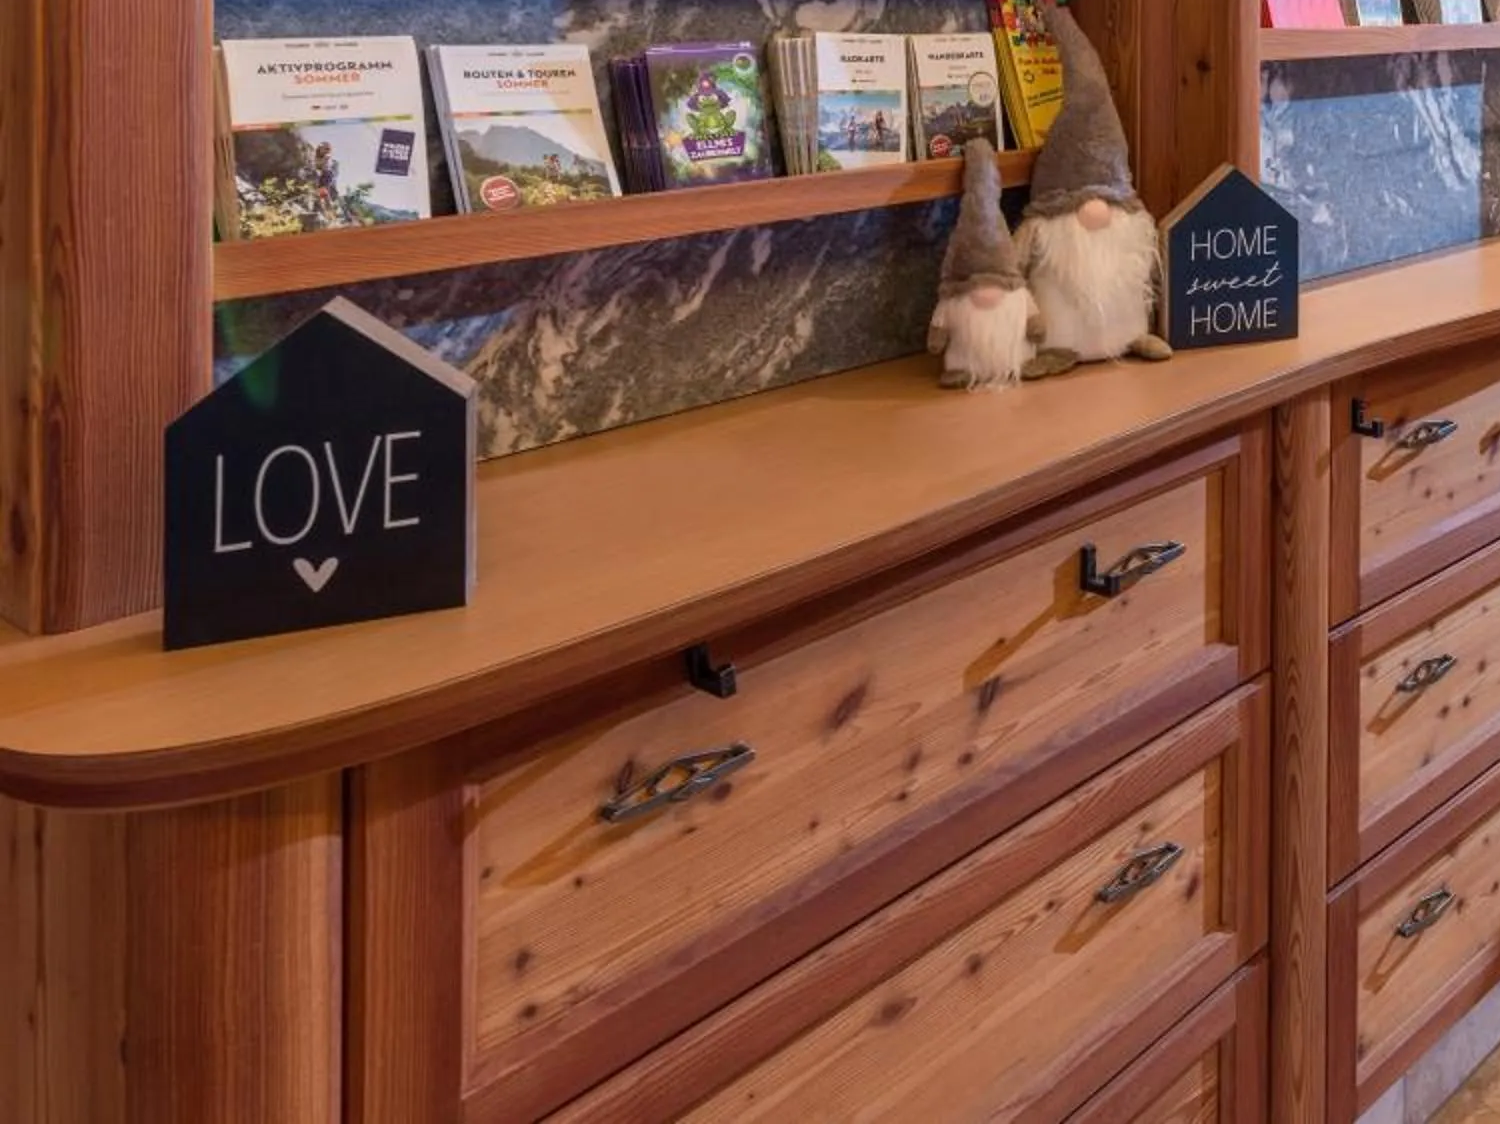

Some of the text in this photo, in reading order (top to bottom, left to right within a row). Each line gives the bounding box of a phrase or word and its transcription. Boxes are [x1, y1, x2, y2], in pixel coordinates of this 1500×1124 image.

[257, 60, 393, 75] AKTIVPROGRAMM
[294, 72, 361, 85] SOMMER
[463, 69, 513, 79] ROUTEN
[527, 69, 577, 79] TOUREN
[496, 79, 549, 89] SOMMER
[1190, 224, 1279, 262] HOME
[1186, 261, 1284, 295] sweet
[1190, 297, 1279, 337] HOME
[213, 430, 422, 553] LOVE
